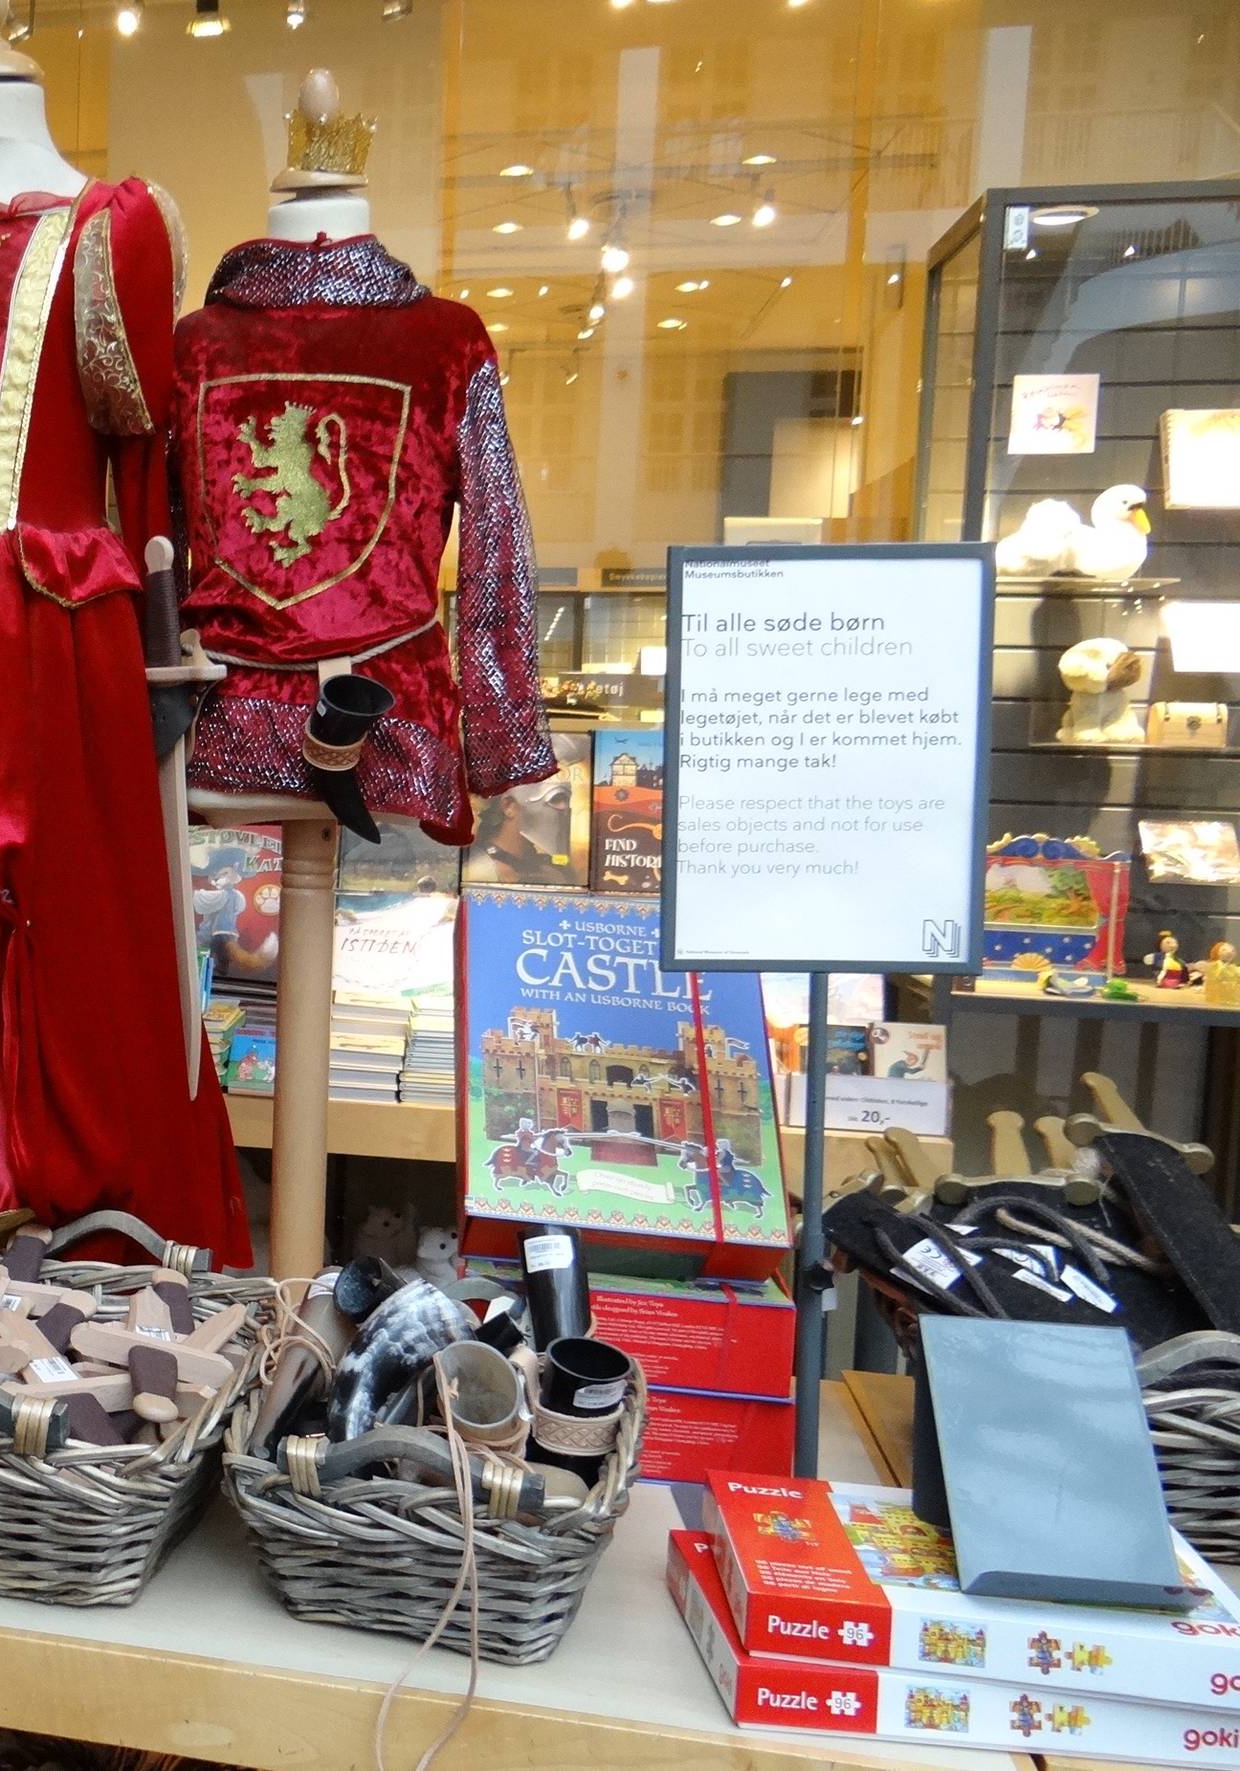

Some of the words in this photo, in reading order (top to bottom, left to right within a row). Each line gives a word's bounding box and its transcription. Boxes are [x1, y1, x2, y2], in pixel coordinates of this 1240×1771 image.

[684, 569, 784, 579] Museumsbutikken
[681, 613, 708, 632] Til
[716, 612, 756, 632] alle
[763, 611, 822, 632] søde
[830, 611, 885, 631] børn
[681, 637, 708, 657] To
[715, 637, 739, 657] all
[746, 639, 814, 657] sweet
[820, 635, 913, 656] children
[680, 688, 686, 703] I
[691, 687, 719, 703] må
[724, 689, 782, 707] meget
[786, 690, 839, 706] gerne
[843, 687, 883, 706] lege
[887, 686, 930, 702] med
[680, 709, 763, 729] legetøjet,
[768, 708, 798, 725] når
[802, 709, 832, 725] det
[836, 712, 854, 725] er
[859, 708, 915, 725] blevet
[919, 707, 959, 725] købt
[679, 732, 685, 747] i
[689, 731, 766, 747] butikken
[770, 734, 794, 751] og
[809, 735, 827, 747] er
[831, 730, 908, 747] kommet
[911, 730, 962, 751] hjem.
[679, 753, 731, 773] Rigtig
[736, 756, 800, 772] mange
[804, 752, 837, 769] tak!
[678, 795, 736, 811] Please
[739, 796, 803, 816] respect
[806, 795, 841, 811] that
[845, 795, 873, 811] the
[877, 796, 914, 816] toys
[917, 798, 946, 811] are
[677, 816, 722, 833] sales
[725, 816, 789, 836] objects
[791, 816, 826, 833] and
[830, 817, 861, 833] not
[863, 815, 887, 832] for
[892, 818, 924, 832] use
[605, 838, 638, 852] FIND
[677, 837, 733, 854] before
[736, 838, 820, 857] purchase.
[675, 859, 728, 875] Thank
[730, 862, 762, 879] you
[765, 862, 802, 879] very
[804, 859, 860, 876] much!
[574, 920, 648, 938] USBORNE
[922, 919, 961, 959] N
[521, 929, 659, 956] SLOT-TOGET
[519, 987, 561, 1001] WITH
[564, 991, 587, 1003] AN
[590, 994, 664, 1011] USBORNE
[861, 1110, 891, 1125] 20,-
[727, 1481, 805, 1499] Puzzle
[767, 1614, 830, 1640] Puzzle
[846, 1627, 864, 1640] 96
[1171, 1620, 1240, 1637] gok
[1210, 1672, 1240, 1696] go
[757, 1687, 819, 1711] Puzzle
[834, 1697, 852, 1710] 96
[1183, 1727, 1240, 1751] goki
